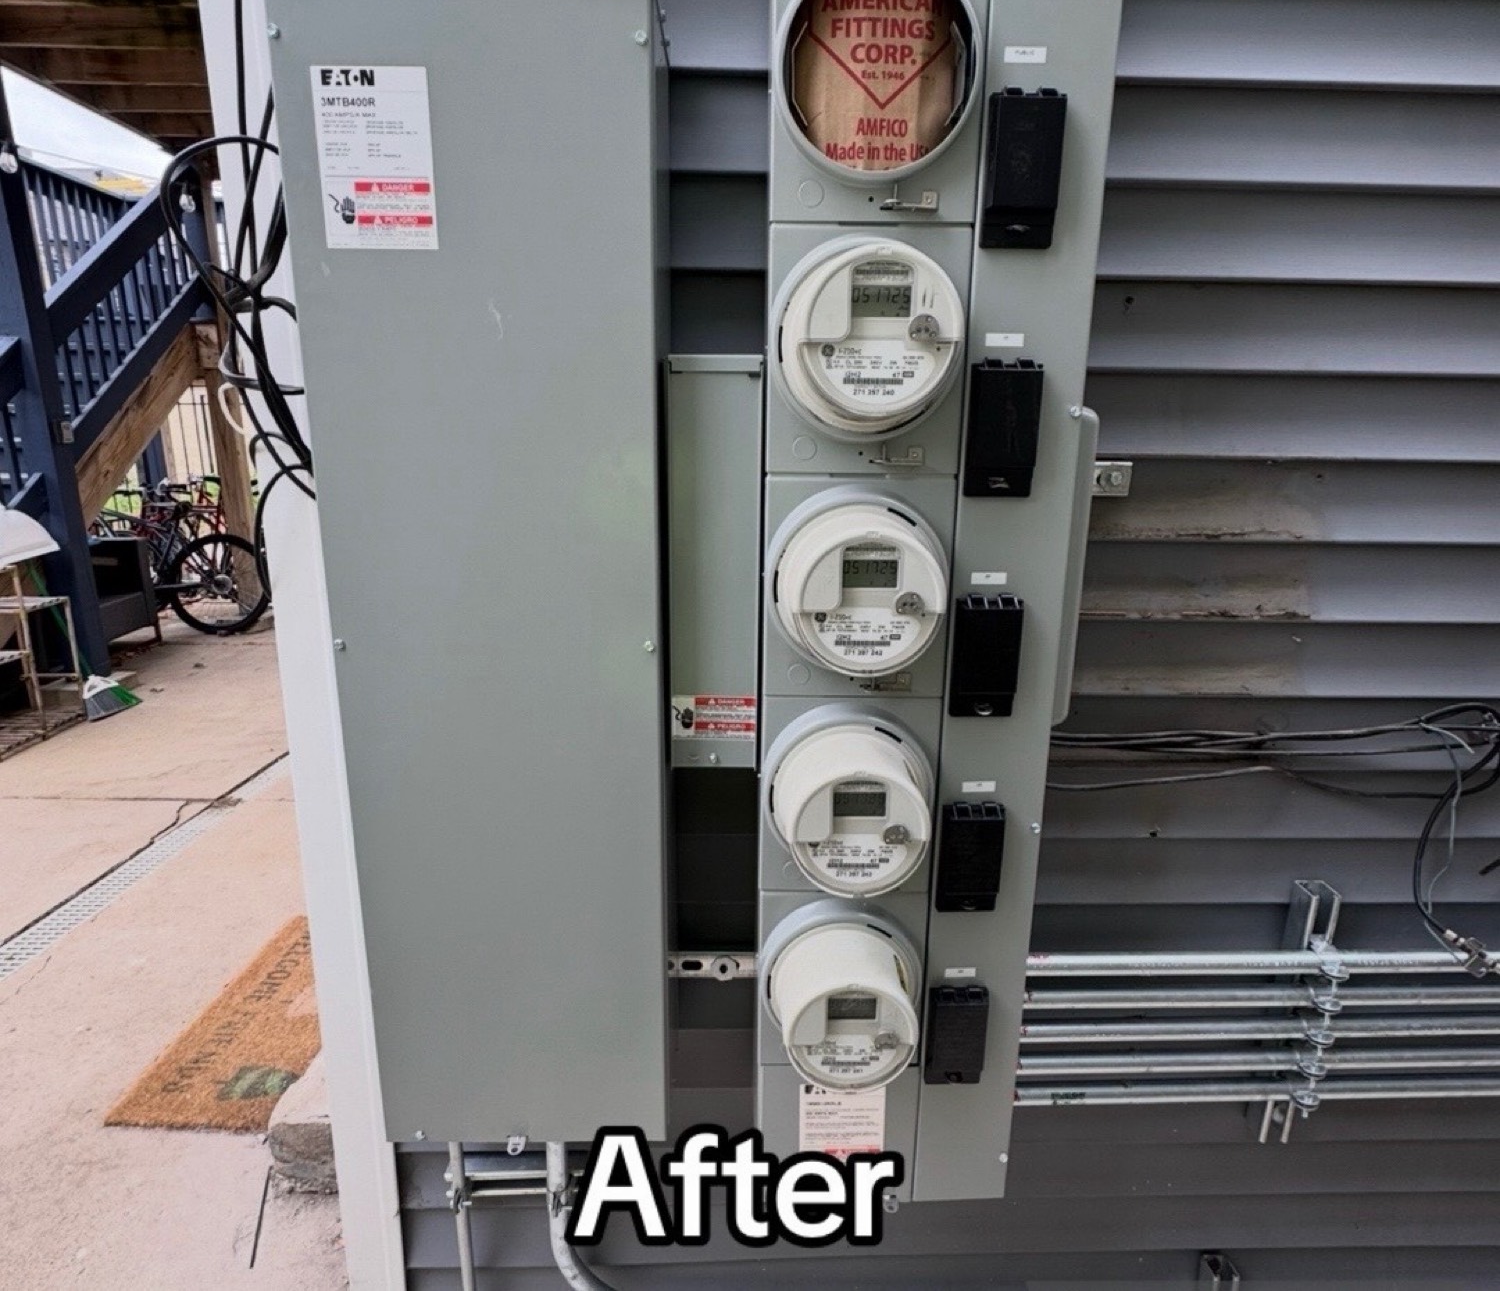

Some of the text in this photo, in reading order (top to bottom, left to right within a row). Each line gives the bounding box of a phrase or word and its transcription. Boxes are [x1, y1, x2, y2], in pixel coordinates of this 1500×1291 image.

[831, 16, 936, 41] FITTINGS
[850, 43, 917, 65] CORP.
[861, 70, 905, 81] Est. 1946
[321, 97, 376, 107] 3MTB400R
[856, 117, 908, 138] AMFICO
[826, 142, 864, 161] Made
[867, 142, 880, 160] in
[883, 142, 907, 161] the
